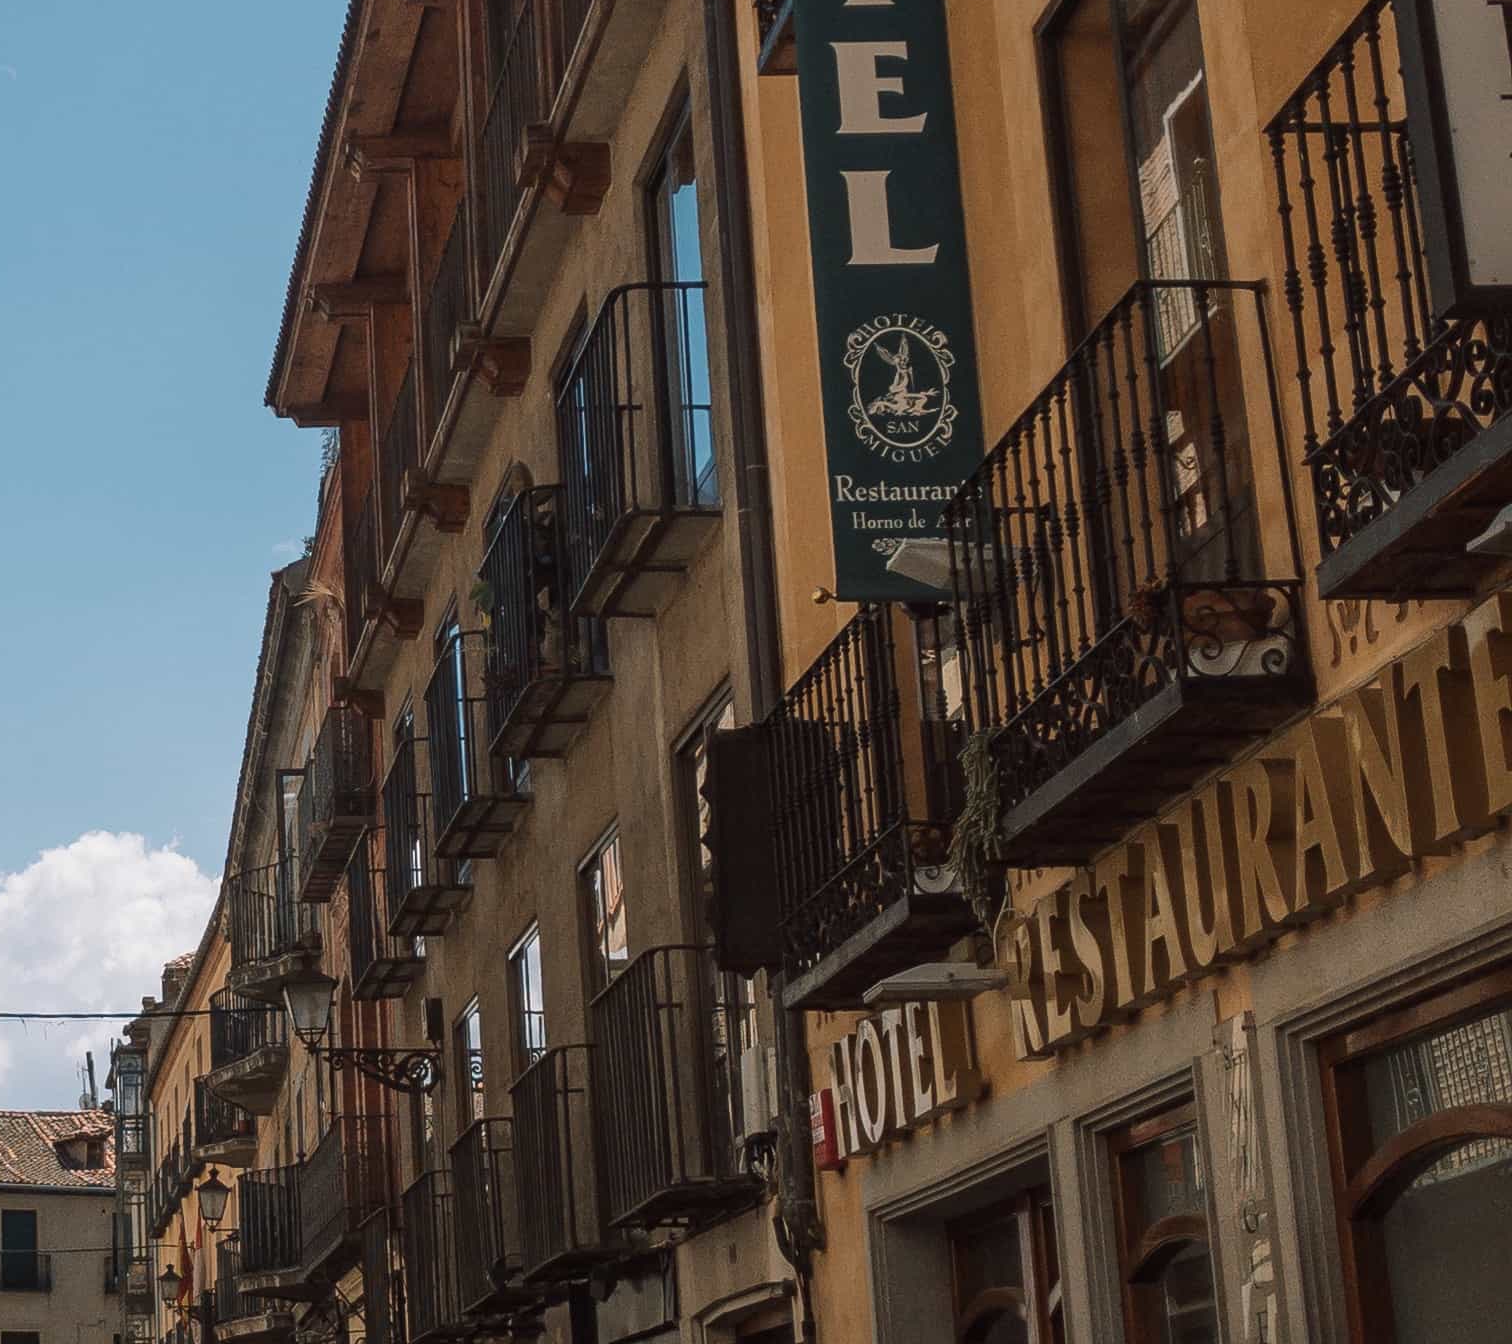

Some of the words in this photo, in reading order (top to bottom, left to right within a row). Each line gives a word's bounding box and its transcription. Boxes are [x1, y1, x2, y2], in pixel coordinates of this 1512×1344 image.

[856, 313, 934, 338] HOTEL
[887, 420, 919, 433] SAN
[864, 435, 952, 463] MIGUEL
[852, 511, 904, 529] Horno
[908, 508, 927, 529] de
[1000, 591, 1512, 1061] RESTAURANTE
[829, 1000, 958, 1161] HOTEL
